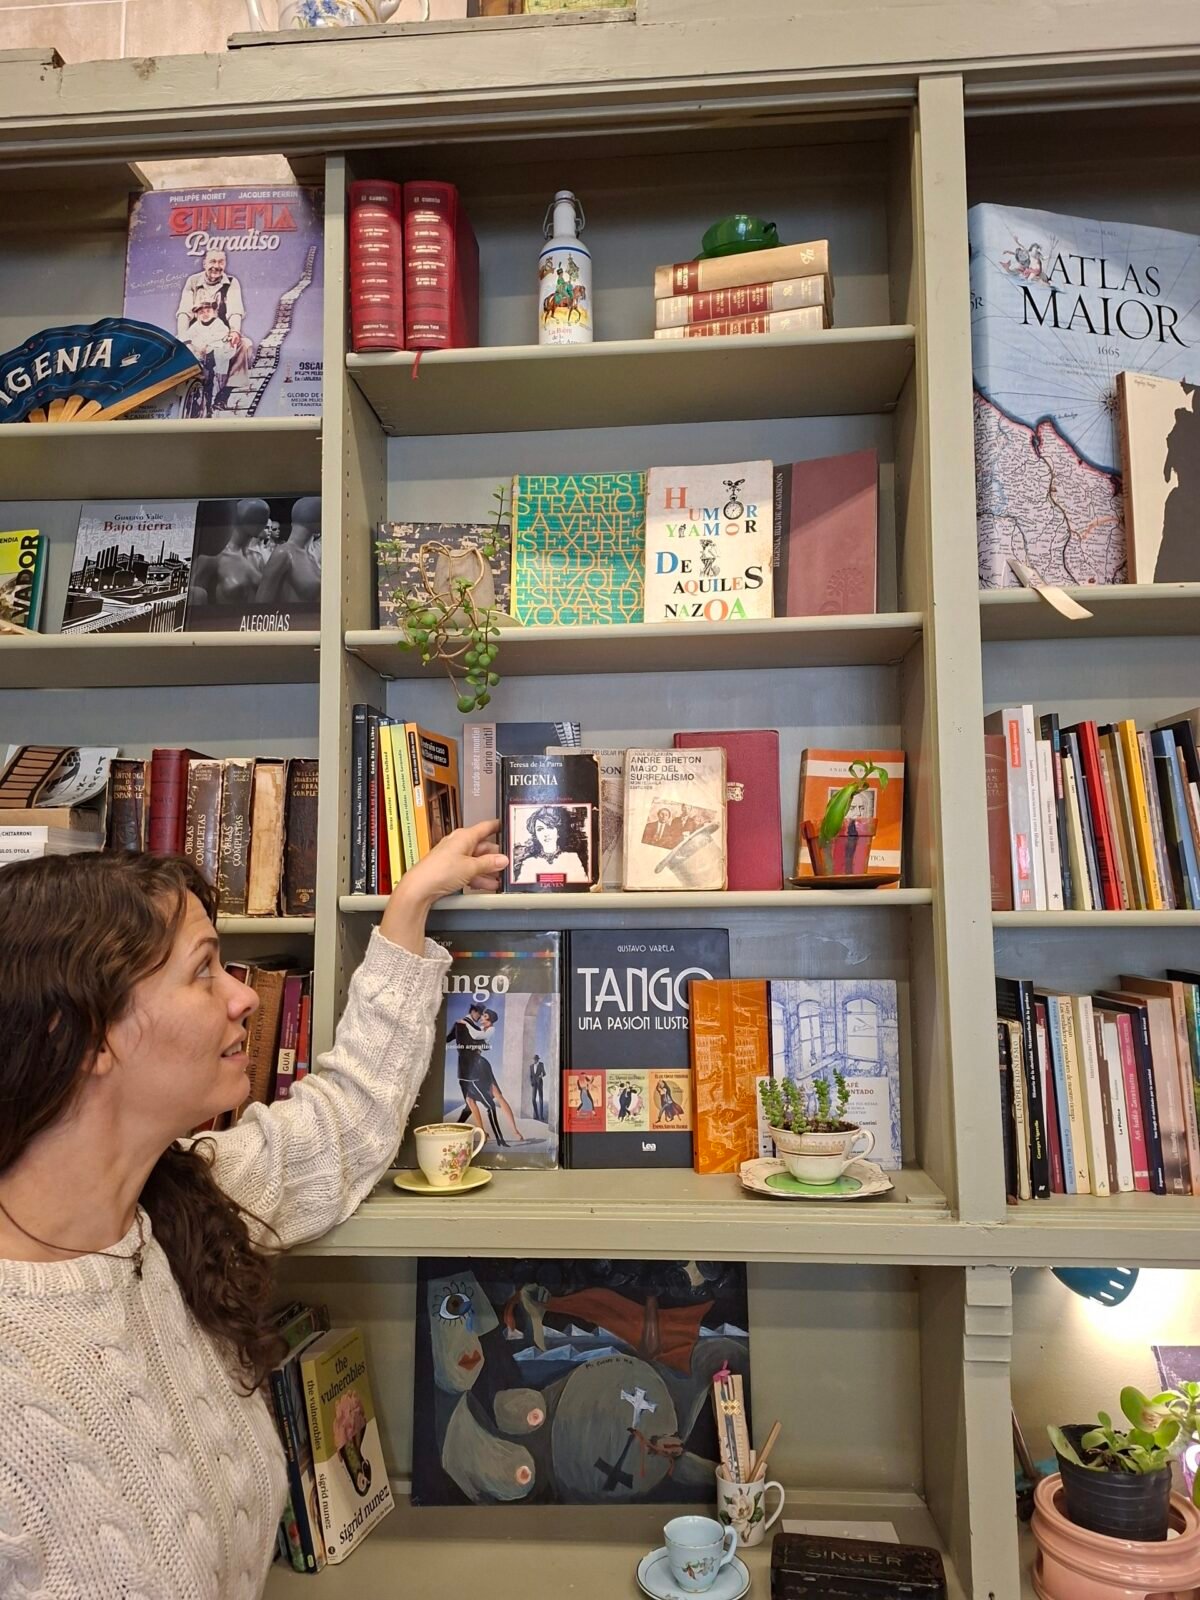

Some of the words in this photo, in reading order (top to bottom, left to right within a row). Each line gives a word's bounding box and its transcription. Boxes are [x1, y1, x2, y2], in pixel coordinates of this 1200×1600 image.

[169, 194, 200, 202] PHILIPPE
[238, 191, 271, 199] JACQUES
[169, 204, 297, 236] CINEMA
[185, 229, 281, 257] Paradiso
[1047, 252, 1160, 297] ATLAS
[1018, 285, 1191, 348] MAIOR
[1098, 346, 1120, 357] 1665
[526, 474, 632, 495] FRASES
[103, 520, 133, 533] Bajo
[137, 521, 172, 532] tierra
[114, 513, 143, 521] Gustavo
[775, 511, 782, 520] DE
[655, 551, 692, 575] DE
[673, 566, 763, 596] AQUILES
[240, 610, 290, 632] ALEGORÍAS
[664, 597, 747, 624] NAZOA
[472, 728, 480, 752] montiel
[483, 728, 492, 748] inútil
[483, 751, 493, 774] diario
[600, 767, 622, 775] SON
[630, 765, 658, 773] MAGO
[665, 756, 702, 764] BRETON
[472, 772, 480, 796] ricardo
[510, 775, 558, 786] IFIGENIA
[185, 826, 194, 855] OBRAS
[195, 814, 206, 866] COMPLETAS
[224, 826, 234, 855] OBRAS
[233, 814, 244, 867] COMPLETAS
[617, 945, 647, 953] GUSTAVO
[649, 945, 675, 953] VARELA
[578, 1017, 602, 1030] UNA
[607, 1016, 651, 1030] PASIÓN
[655, 1016, 689, 1030] ILUSTR
[1013, 1040, 1022, 1111] IMPRESIONISMO
[1062, 1044, 1071, 1073] pensadores
[1068, 1103, 1076, 1122] tiempo
[1129, 1074, 1137, 1108] Zaratustra
[1017, 1114, 1023, 1124] EL
[642, 1142, 657, 1150] Lea
[335, 1356, 347, 1375] the
[321, 1361, 366, 1405] vulnerables
[310, 1398, 322, 1450] vulnerables
[318, 1473, 328, 1499] sigrid
[322, 1501, 332, 1529] nunez
[340, 1507, 363, 1544] sigrid
[364, 1485, 389, 1518] nunez
[806, 1550, 902, 1567] SINGER
